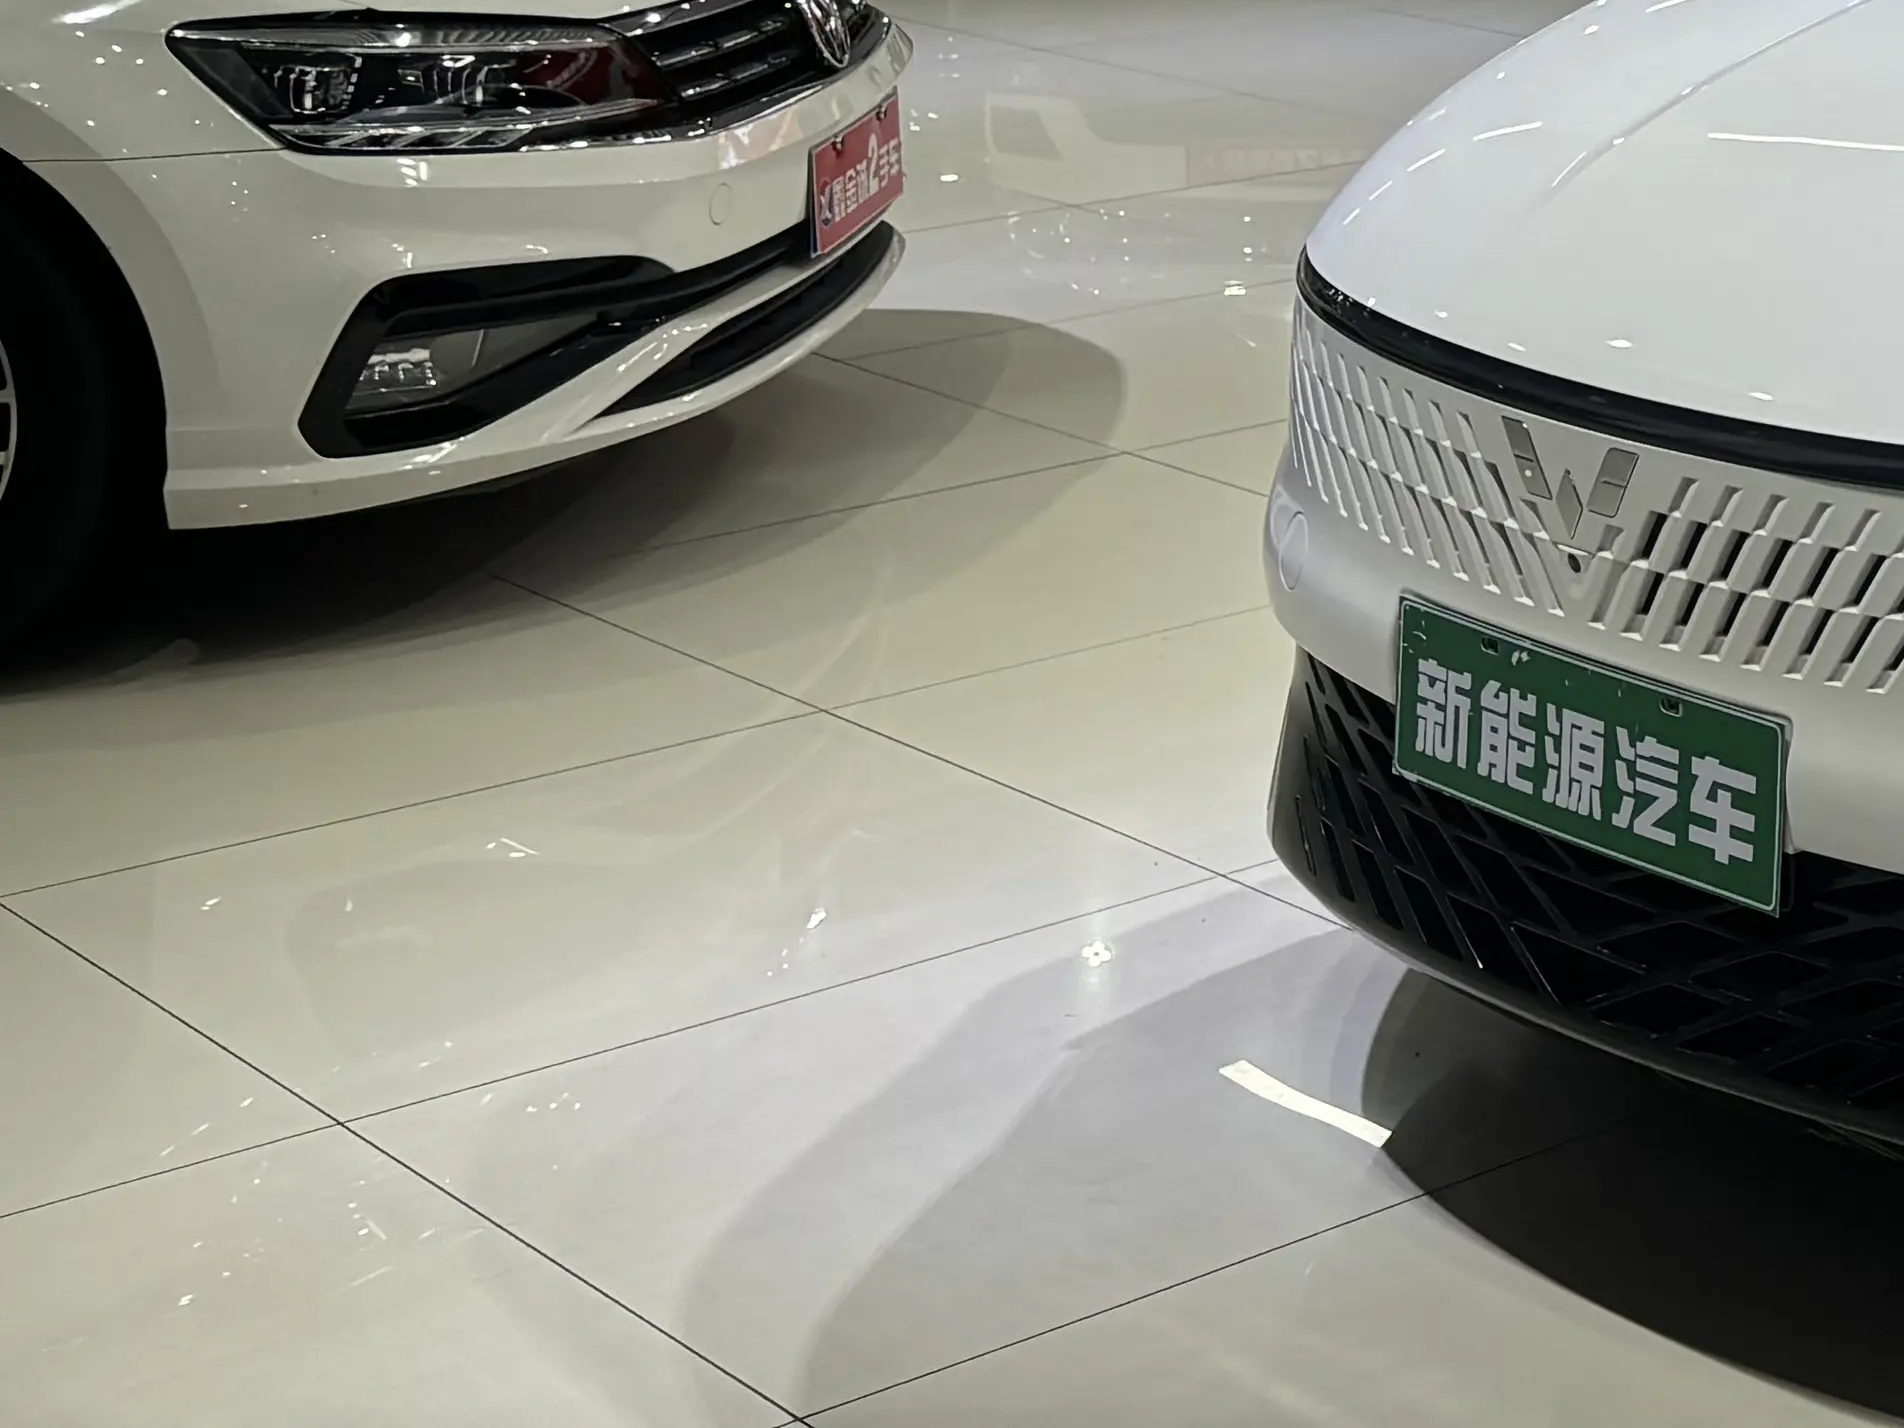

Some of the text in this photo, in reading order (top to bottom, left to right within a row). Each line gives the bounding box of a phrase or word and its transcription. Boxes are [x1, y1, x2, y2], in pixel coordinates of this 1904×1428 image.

[1414, 657, 1758, 865] 新能源汽车
